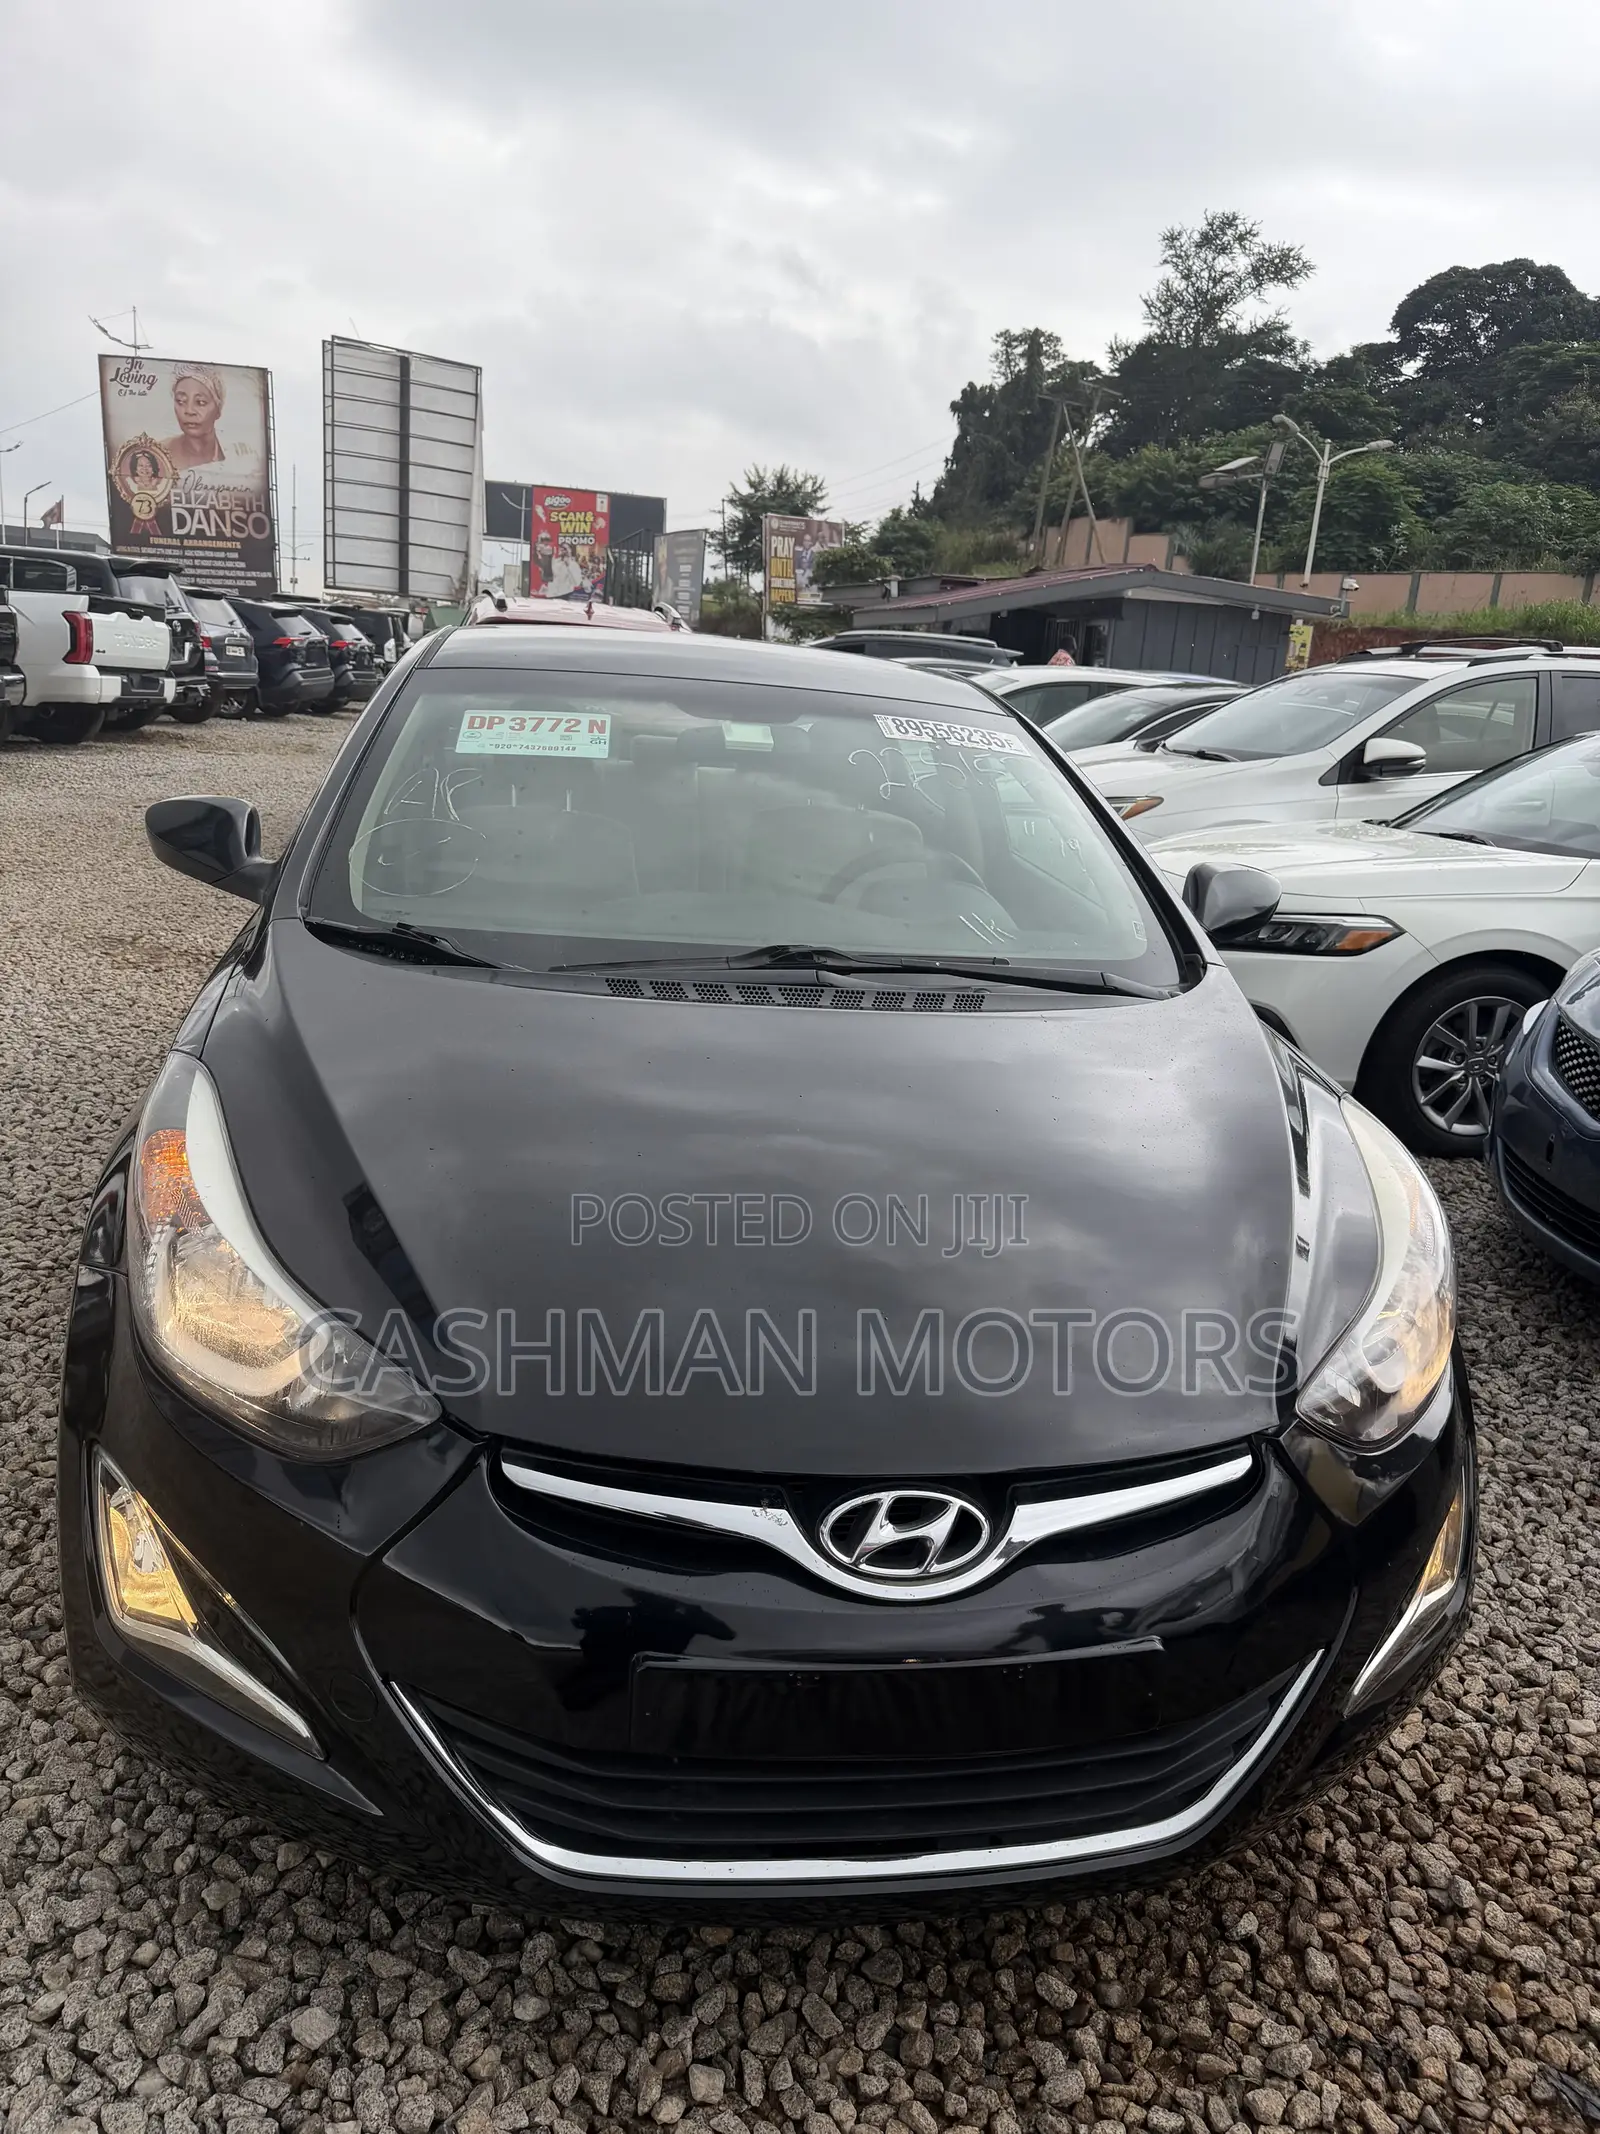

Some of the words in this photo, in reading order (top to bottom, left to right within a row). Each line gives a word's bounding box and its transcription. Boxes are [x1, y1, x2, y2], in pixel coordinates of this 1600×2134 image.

[124, 357, 144, 373] In
[109, 367, 158, 390] Loving
[136, 500, 152, 514] 73
[171, 489, 265, 512] ELIZABETH
[171, 507, 270, 540] DANSO
[560, 522, 591, 533] WIN
[150, 537, 181, 546] FUNERAL
[183, 539, 241, 549] ARRANGEMENTS
[558, 537, 595, 545] PROMO
[771, 536, 795, 558] PRAY
[467, 715, 505, 730] DP
[508, 716, 582, 733] 3772
[588, 719, 606, 734] N
[891, 717, 1006, 749] 89556235
